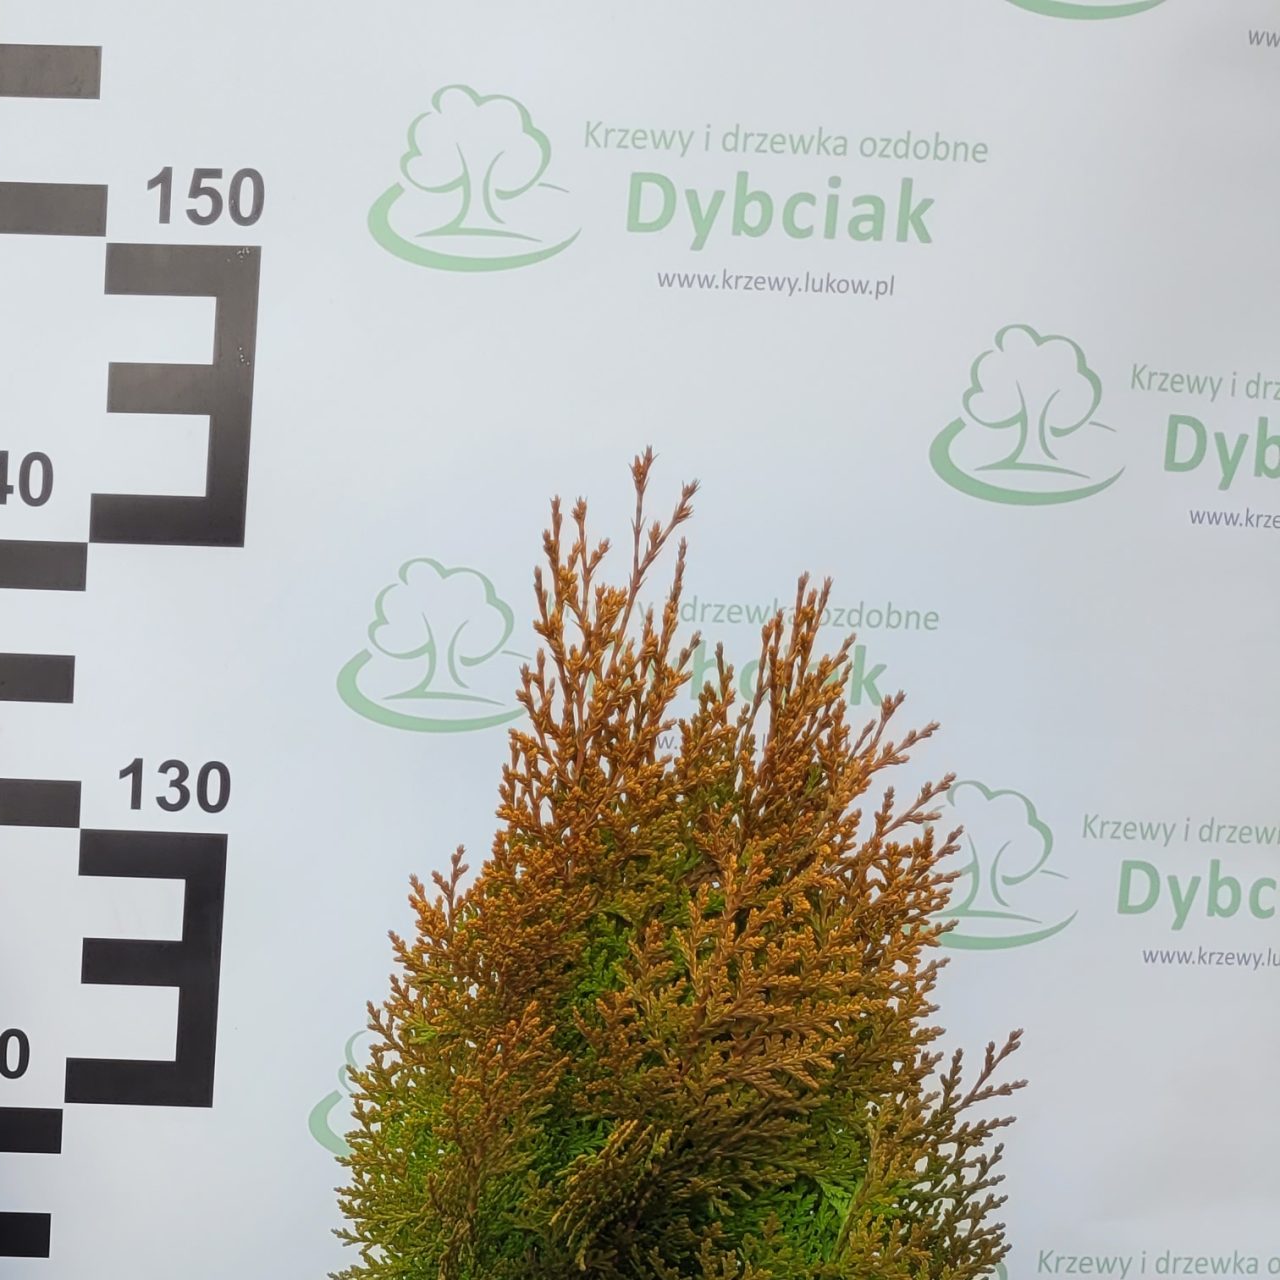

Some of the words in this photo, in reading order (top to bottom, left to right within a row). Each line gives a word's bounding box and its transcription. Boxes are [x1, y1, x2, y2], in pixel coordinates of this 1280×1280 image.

[584, 120, 694, 157] Krzewy
[704, 123, 712, 152] i
[721, 124, 848, 156] drzewka
[859, 131, 989, 163] ozdobne
[147, 166, 265, 226] 150
[626, 171, 936, 251] Dybciak
[657, 269, 895, 300] www.krzewy.lukow.pl
[1131, 363, 1223, 402] Krzewy
[1230, 371, 1238, 398] i
[820, 601, 939, 631] ozdobne
[119, 758, 231, 813] 130
[1082, 814, 1176, 847] Krzewy
[1183, 816, 1191, 842] i
[1199, 817, 1280, 844] drzew
[1038, 1250, 1132, 1280] Krzewy
[1140, 1250, 1147, 1274] i
[1155, 1250, 1258, 1274] drzewka
